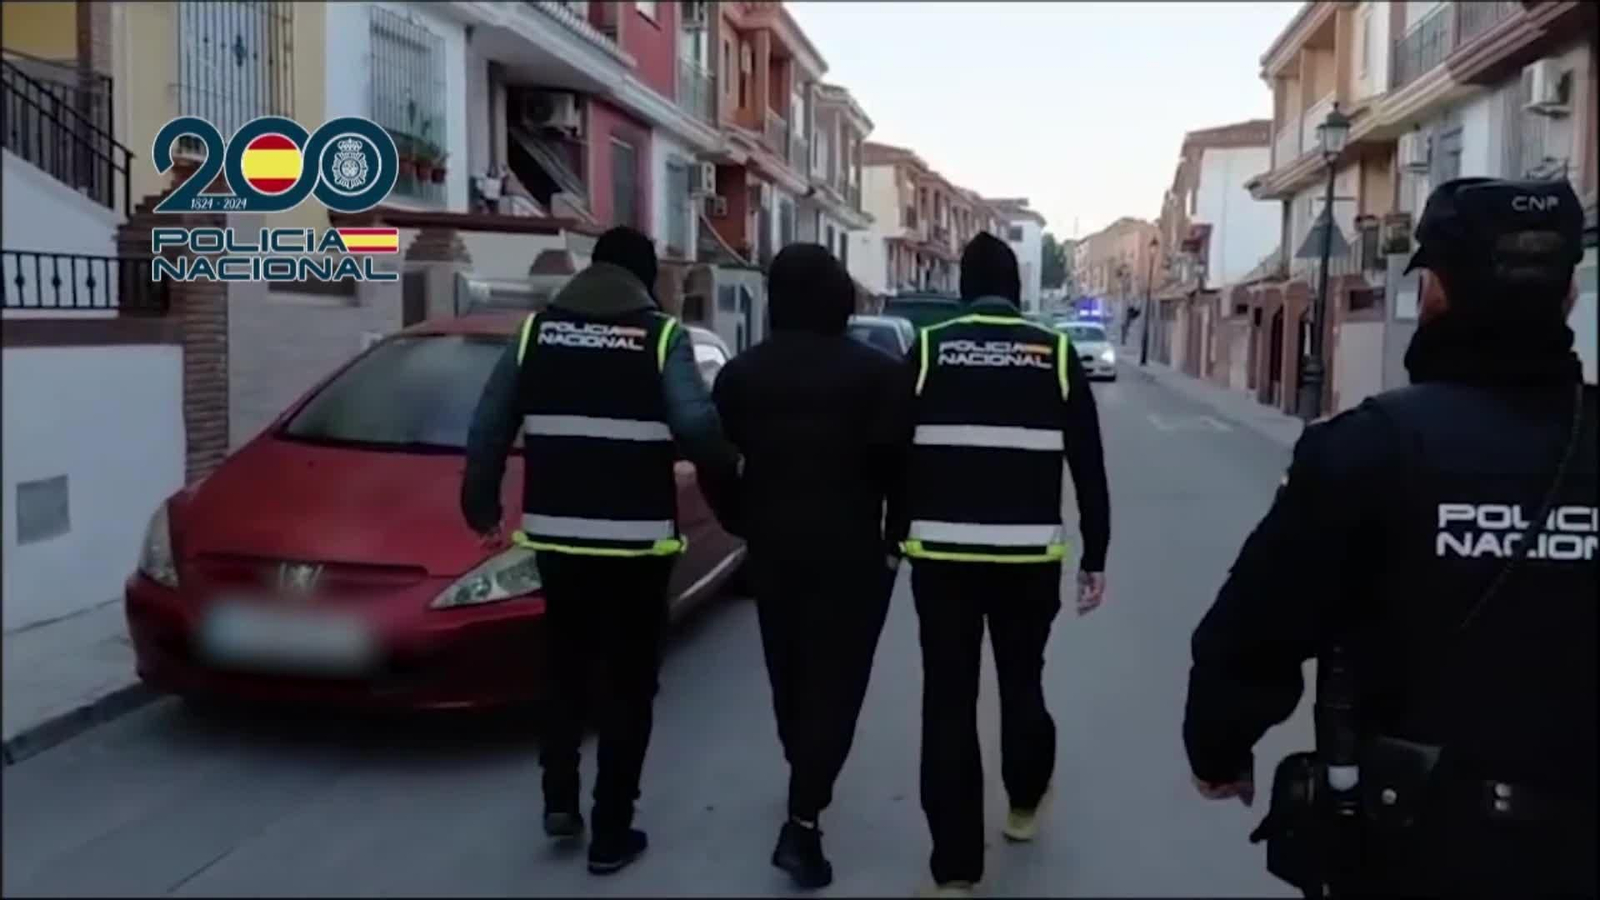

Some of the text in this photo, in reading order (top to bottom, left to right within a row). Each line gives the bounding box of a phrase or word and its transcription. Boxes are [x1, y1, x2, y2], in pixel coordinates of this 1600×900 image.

[1511, 196, 1559, 211] CNP
[538, 333, 644, 351] NACIONAL
[938, 353, 1052, 369] NACIONAL
